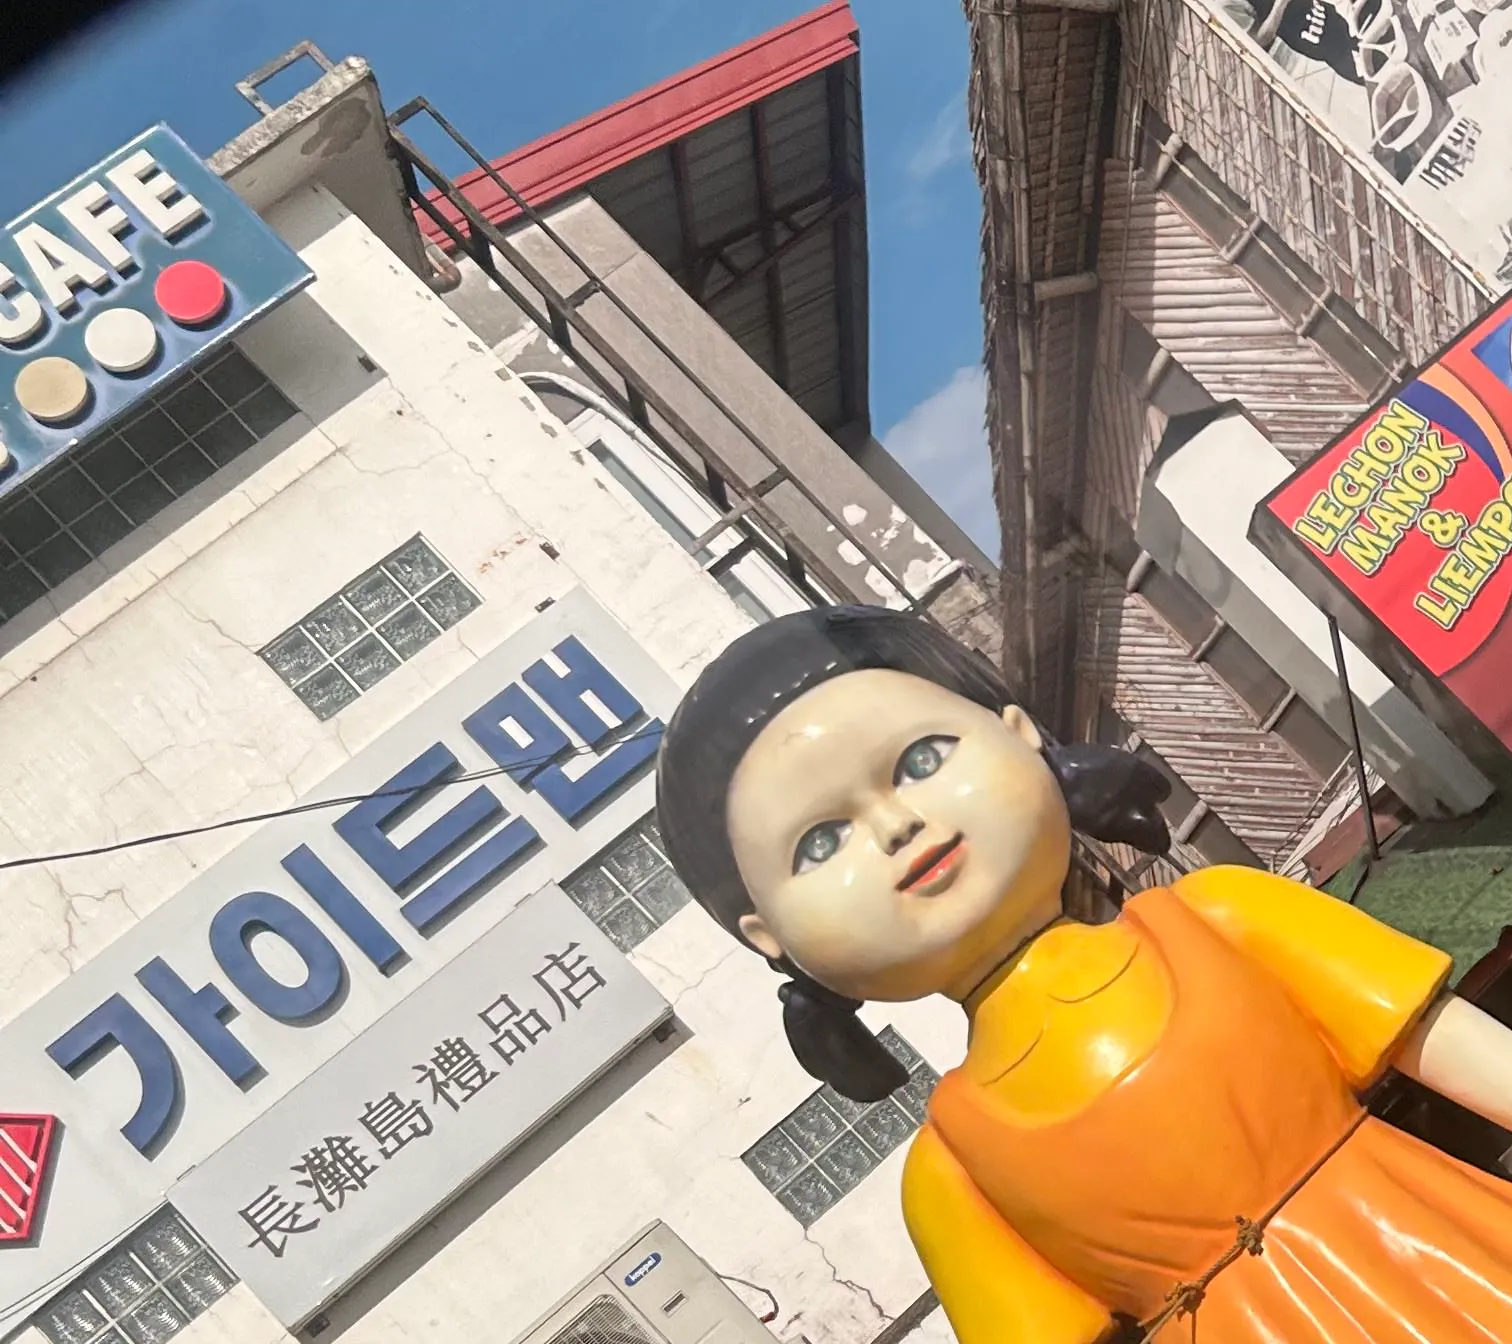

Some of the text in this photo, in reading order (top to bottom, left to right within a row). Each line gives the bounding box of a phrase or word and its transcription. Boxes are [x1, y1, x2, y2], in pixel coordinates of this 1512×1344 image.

[1293, 398, 1430, 555] LECHON
[1339, 431, 1466, 575] MANOK
[1418, 511, 1468, 548] &
[42, 633, 668, 1161] 가이드맨
[234, 939, 609, 1261] 長灘島禮品店
